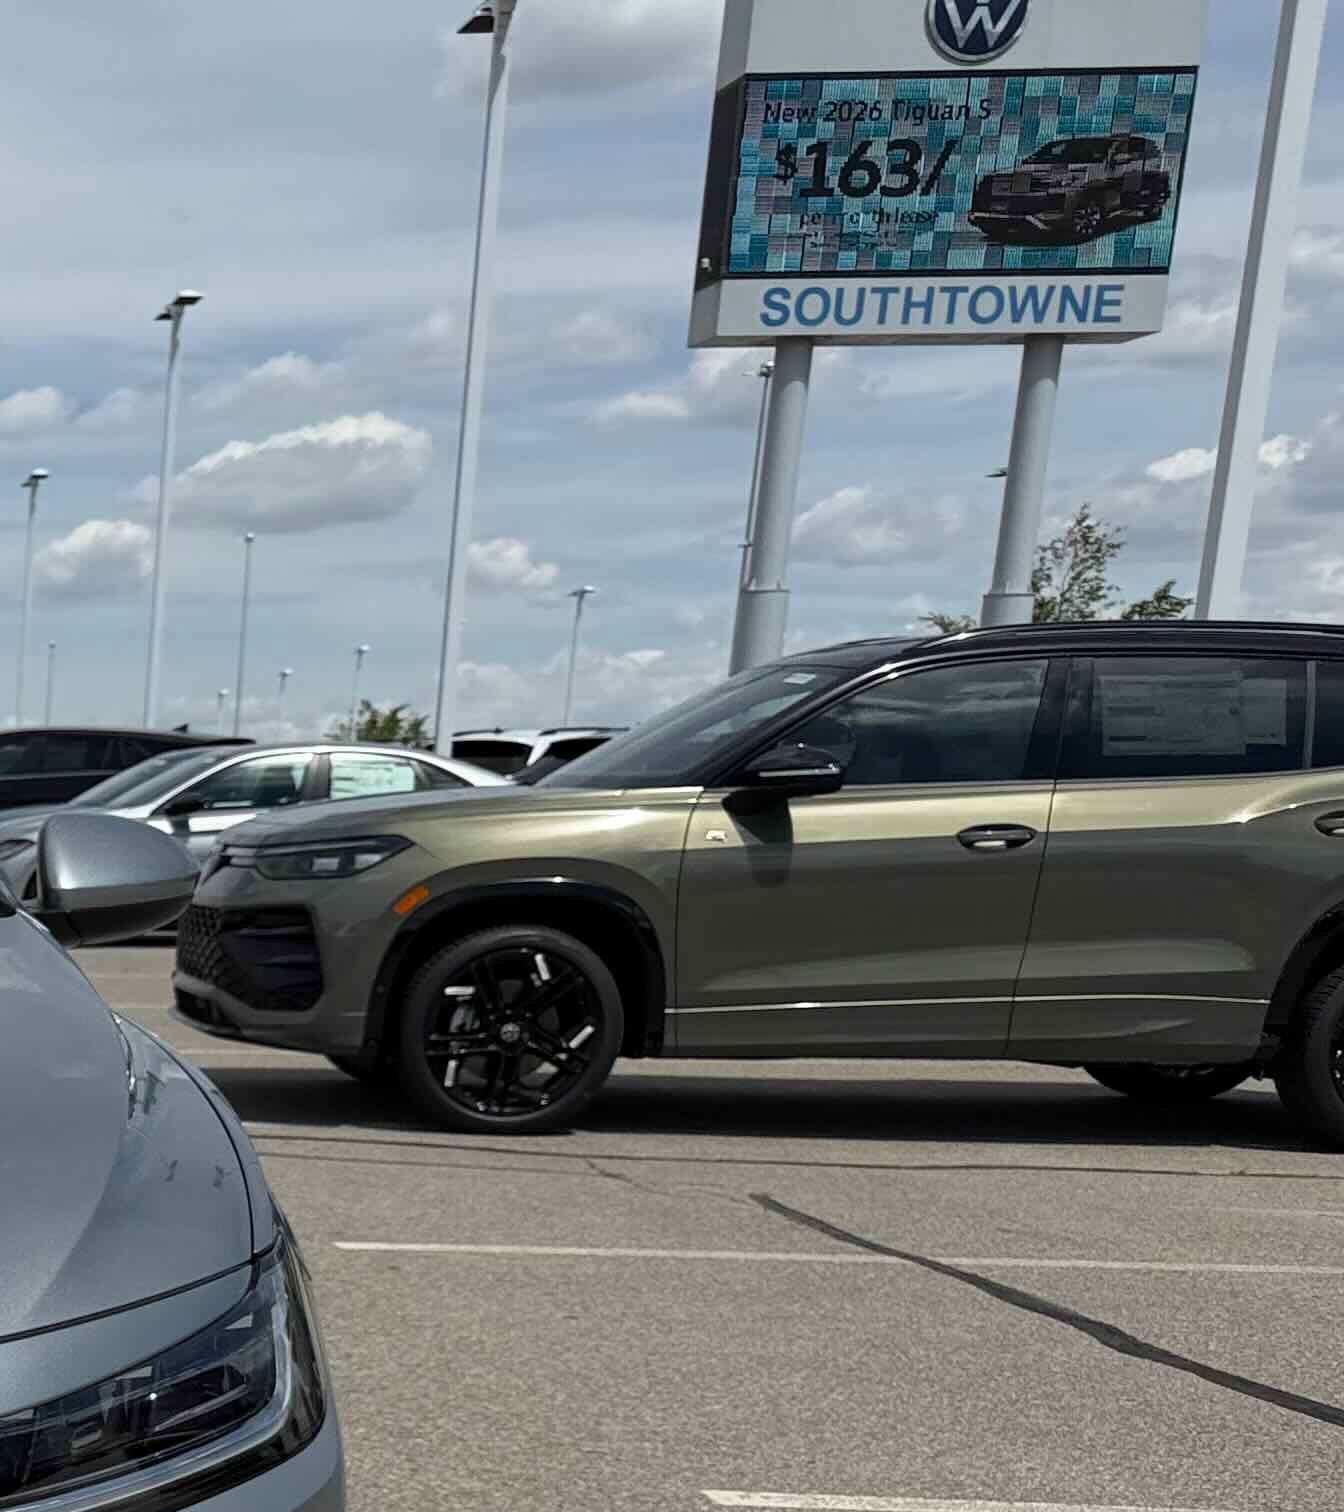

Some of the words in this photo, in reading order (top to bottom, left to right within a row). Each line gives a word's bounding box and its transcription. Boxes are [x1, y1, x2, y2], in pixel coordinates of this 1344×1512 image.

[764, 102, 816, 123] New
[823, 100, 883, 122] 2026
[892, 98, 972, 126] Tiguan
[978, 98, 993, 120] S
[775, 138, 958, 198] $163/
[759, 284, 1125, 327] SOUTHTOWNE
